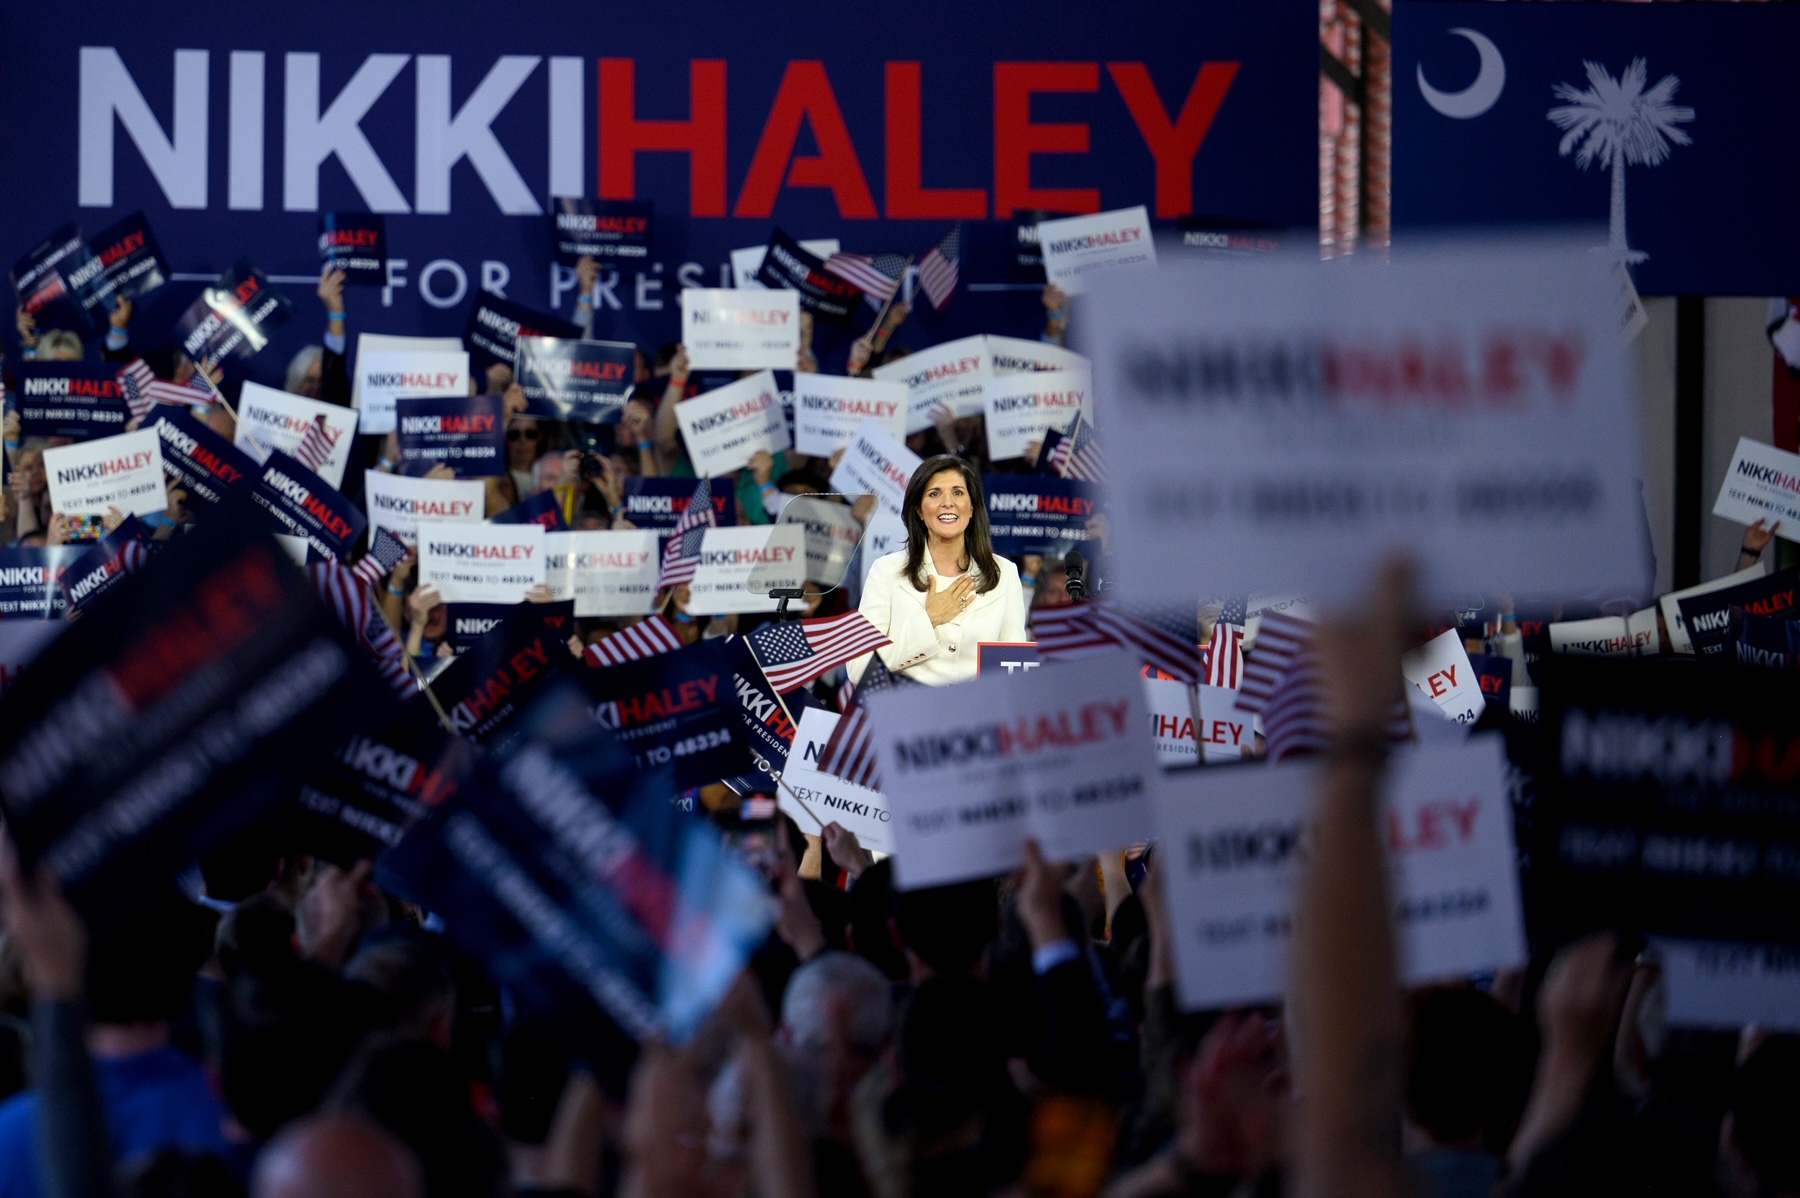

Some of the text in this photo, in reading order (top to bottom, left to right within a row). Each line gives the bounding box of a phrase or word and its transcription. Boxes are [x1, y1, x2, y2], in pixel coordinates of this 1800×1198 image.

[381, 258, 510, 309] FOR
[85, 493, 116, 506] NIKKI
[1728, 488, 1746, 500] TEXT
[1747, 494, 1773, 511] NIKKI
[1775, 502, 1786, 513] TO
[251, 491, 270, 510] TEXT
[269, 504, 297, 530] NIKKI
[296, 525, 309, 537] TO
[1011, 526, 1043, 538] NIKKI
[1045, 526, 1059, 539] TO
[429, 542, 535, 560] NIKKIHALEY
[429, 571, 450, 582] TEXT
[453, 572, 483, 583] NIKKI
[485, 574, 499, 584] TO
[716, 582, 745, 592] NIKKI
[748, 580, 762, 589] TO
[20, 601, 49, 611] NIKKI
[51, 601, 66, 610] TO
[1703, 643, 1723, 656] TEXT
[646, 747, 671, 765] TO
[752, 755, 771, 773] TO
[792, 786, 891, 822] TEXT NIKKI TO
